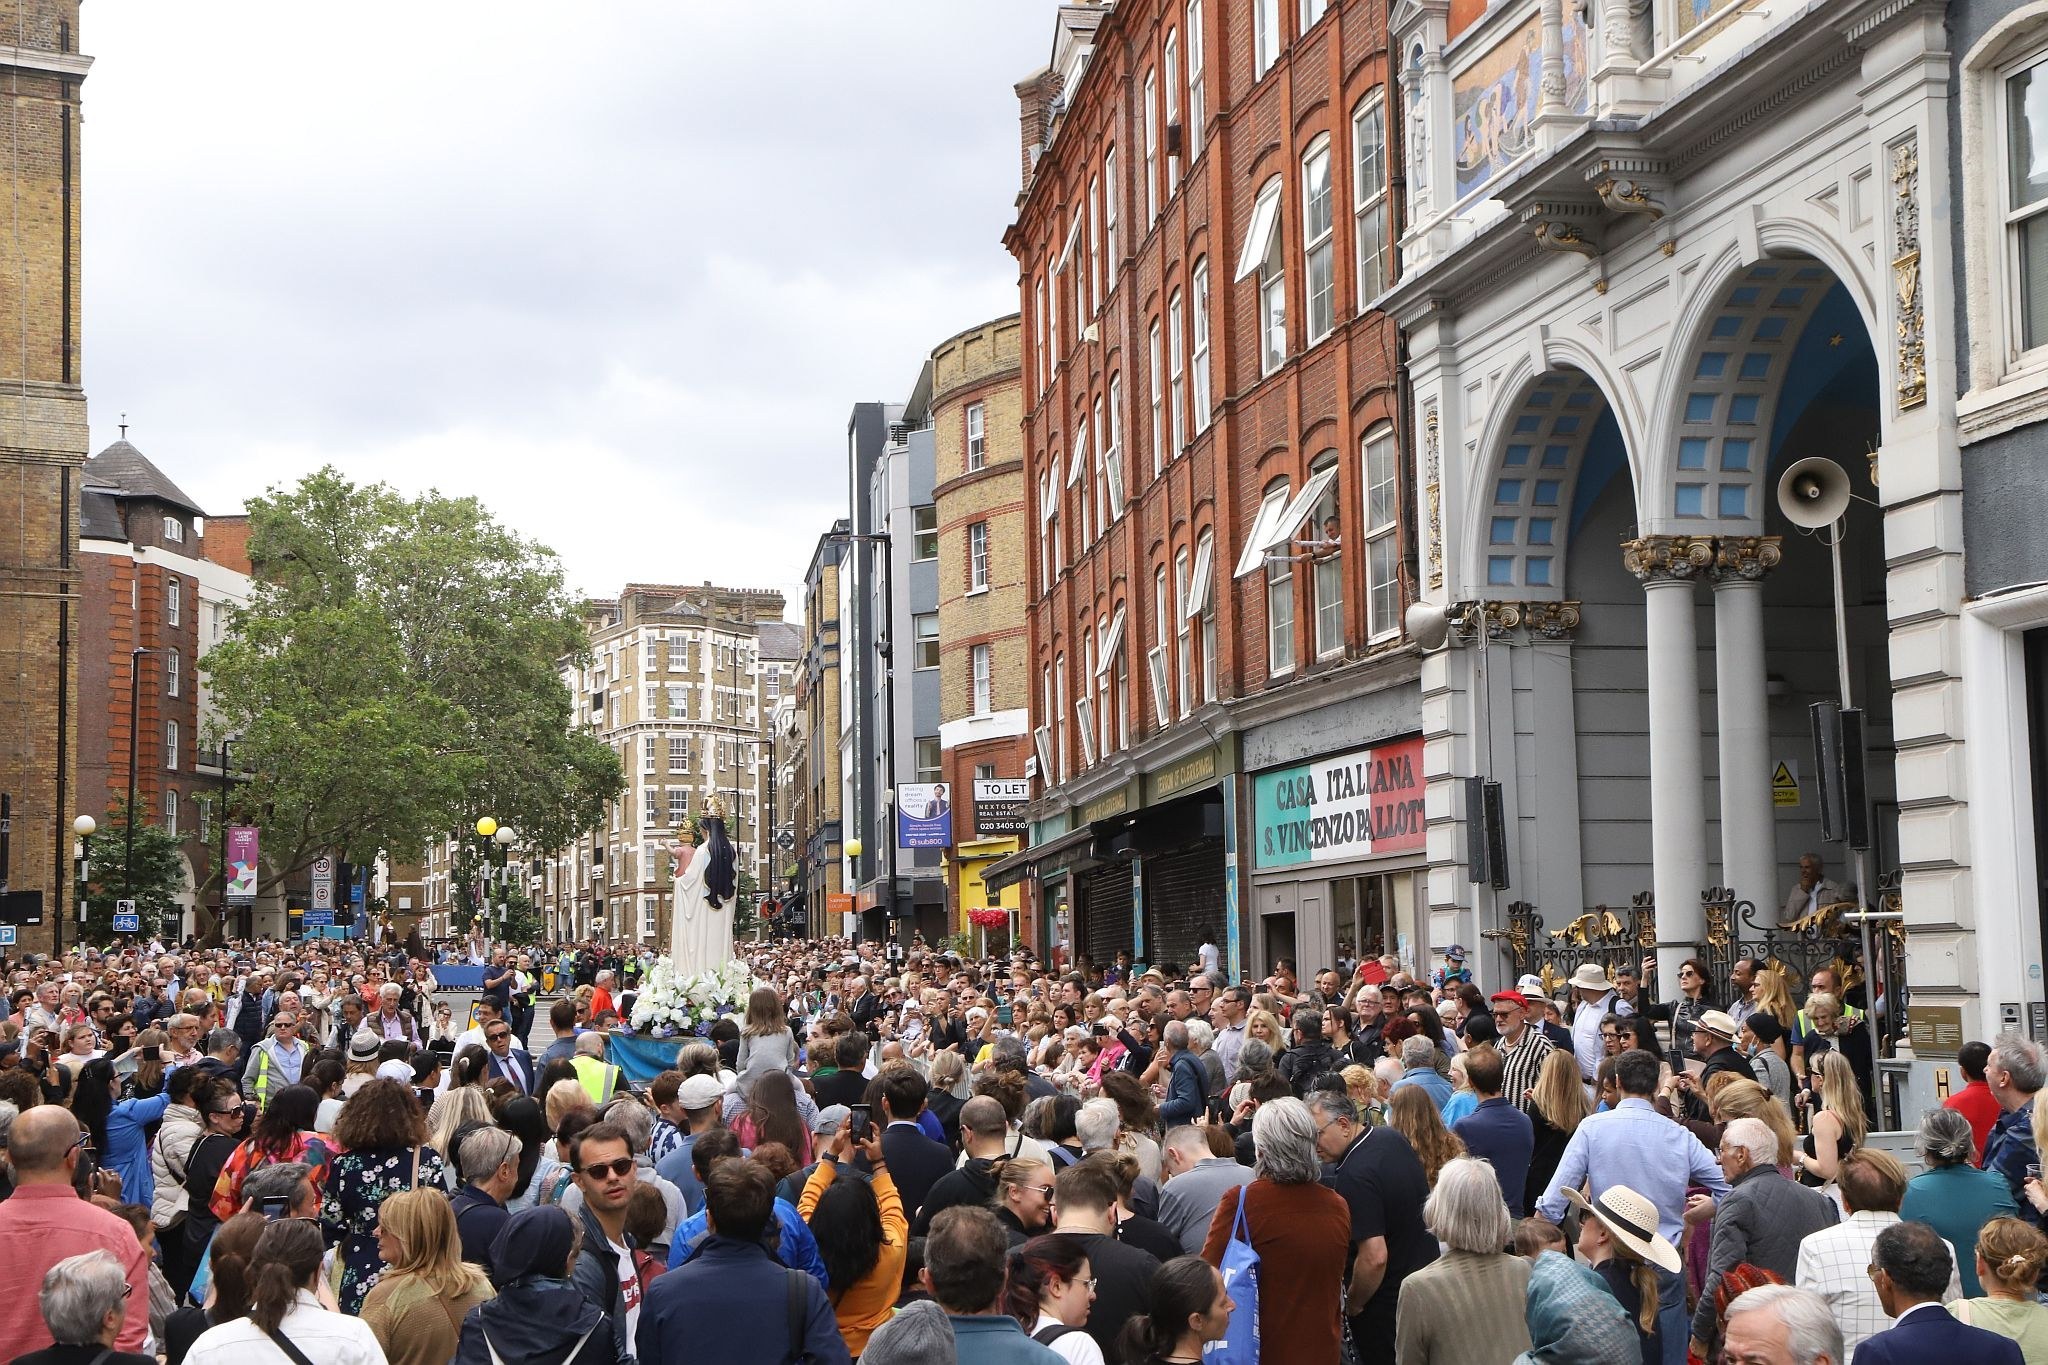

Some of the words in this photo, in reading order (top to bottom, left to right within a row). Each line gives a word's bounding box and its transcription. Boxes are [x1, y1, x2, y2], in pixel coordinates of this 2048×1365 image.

[984, 784, 1001, 794] TO
[1005, 784, 1026, 794] LET
[1276, 774, 1318, 811] CASA
[1326, 754, 1415, 802] ITALIANA
[1264, 825, 1276, 857] S.
[1276, 811, 1354, 854] VINCENZO
[2, 931, 12, 941] P
[1936, 1070, 1950, 1098] H
